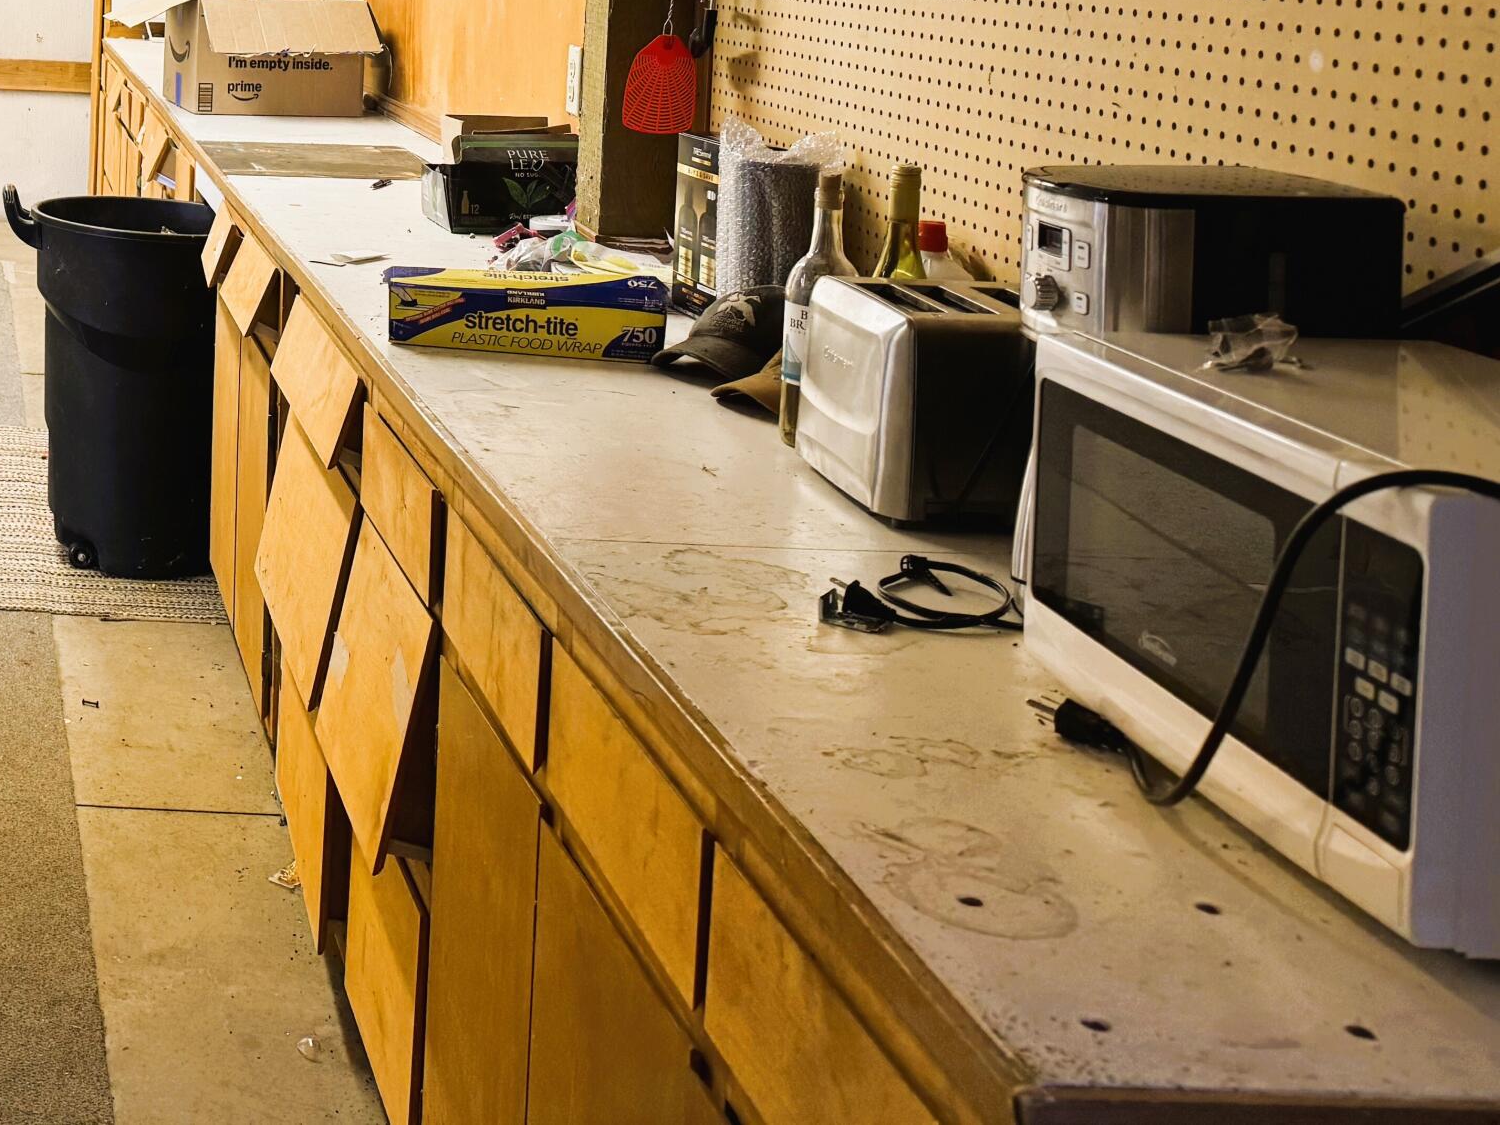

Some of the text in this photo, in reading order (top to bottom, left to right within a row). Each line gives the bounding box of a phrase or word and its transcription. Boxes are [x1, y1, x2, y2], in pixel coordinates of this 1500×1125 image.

[228, 56, 333, 72] I'm empty inside.
[227, 80, 262, 94] prime
[507, 149, 549, 159] PURE
[471, 203, 480, 215] 12
[484, 272, 569, 282] stretch-tite
[627, 279, 658, 289] 750
[506, 289, 545, 297] KIRKLAND
[507, 296, 546, 305] KIRKLAND
[464, 311, 579, 337] stretch-tite
[621, 326, 657, 344] 750
[451, 331, 506, 347] PLASTIC
[510, 335, 553, 350] FOOD
[557, 339, 603, 354] WRAP
